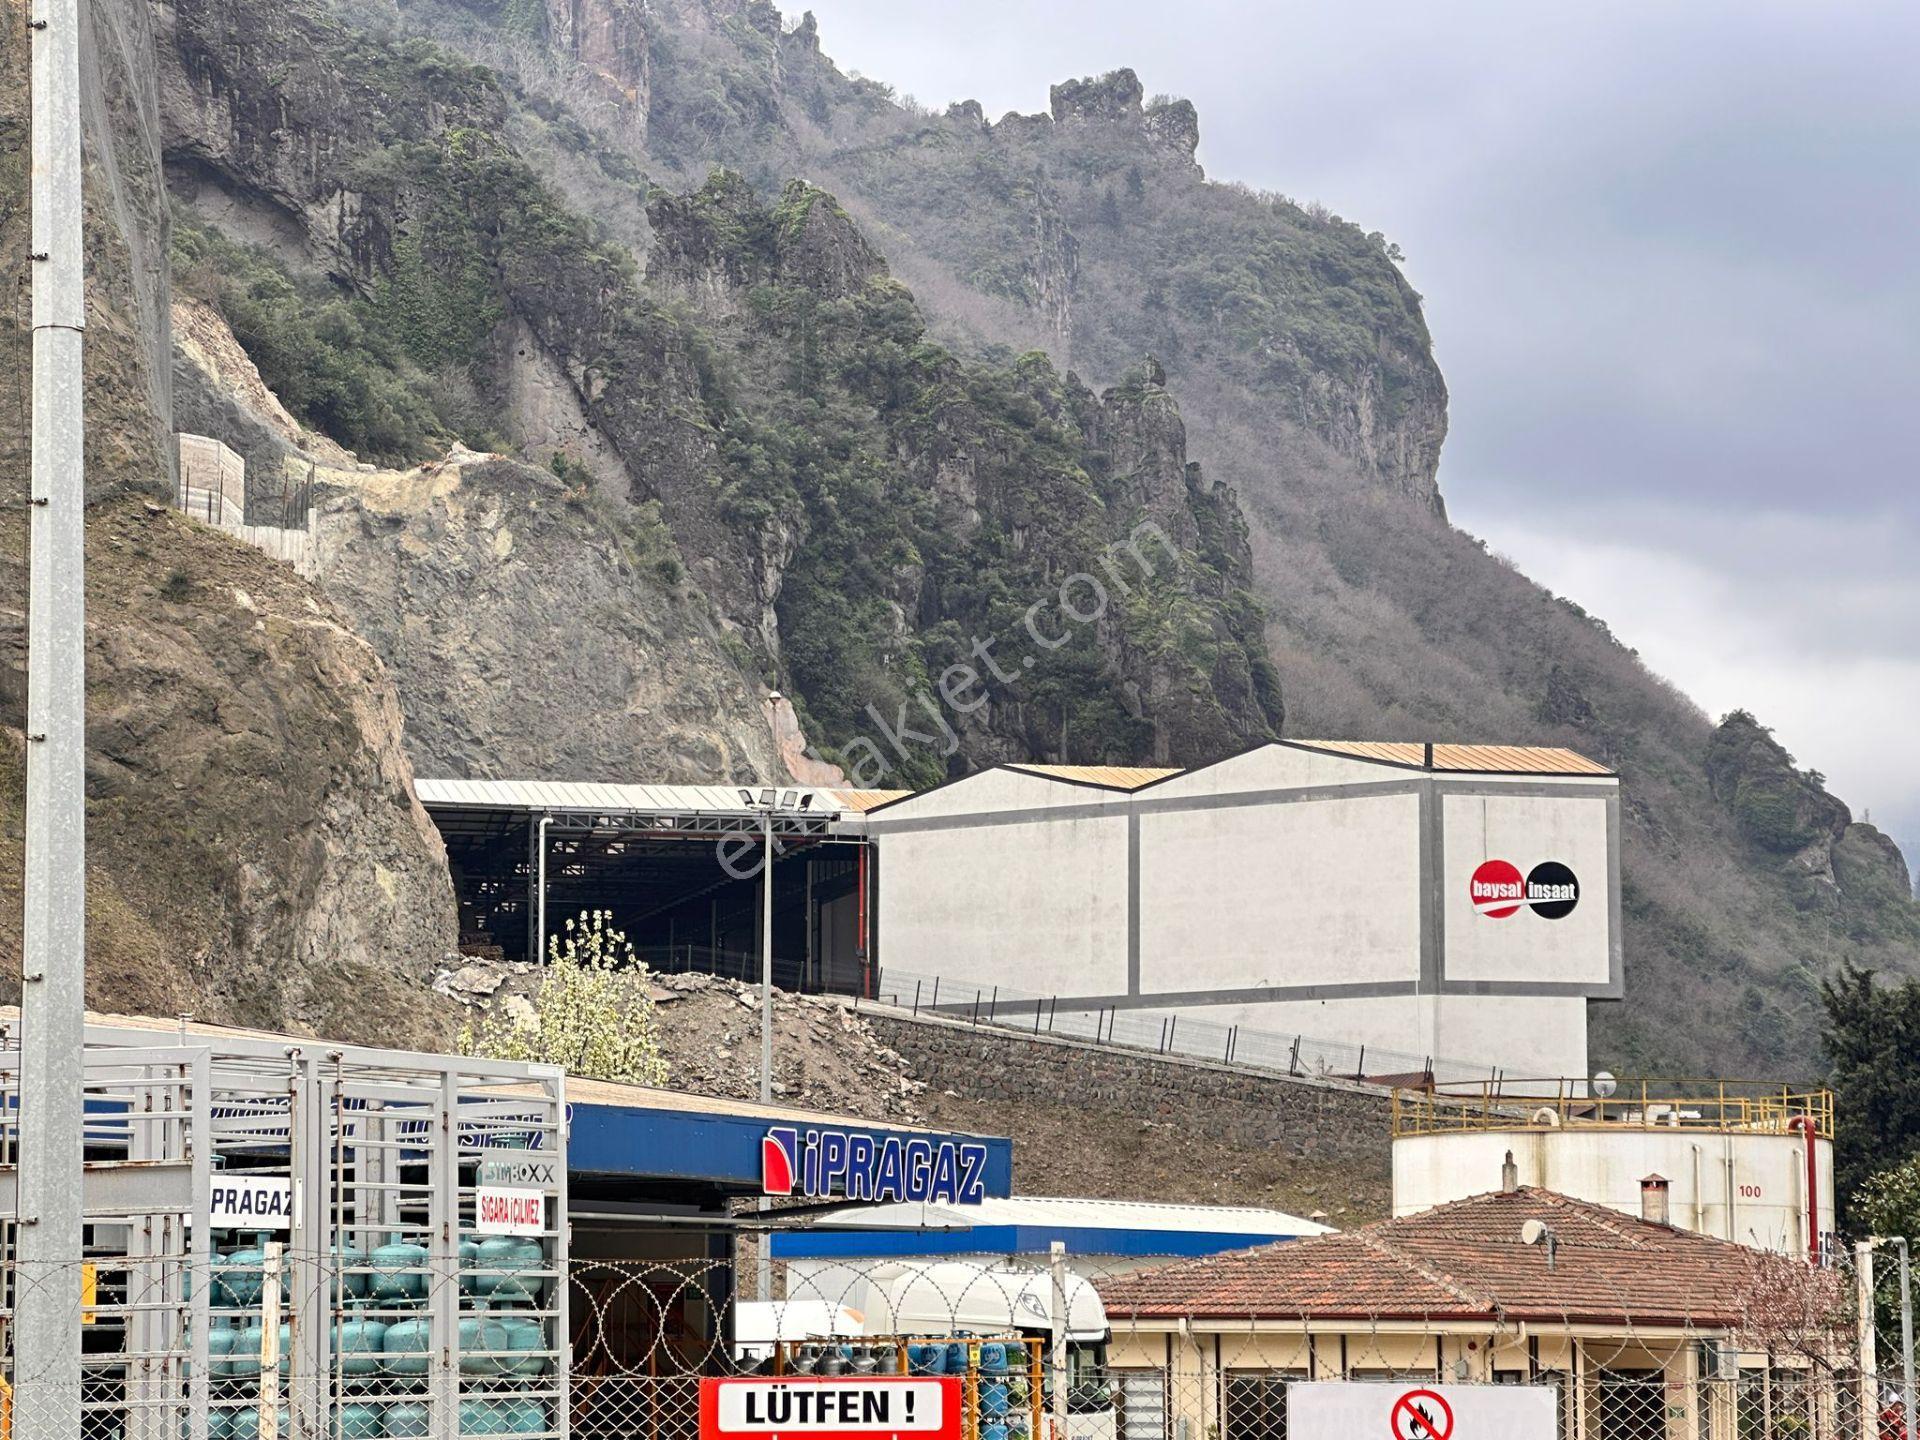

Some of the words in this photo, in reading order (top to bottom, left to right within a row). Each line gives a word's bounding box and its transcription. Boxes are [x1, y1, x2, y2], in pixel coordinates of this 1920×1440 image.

[1473, 880, 1522, 899] baysal
[1739, 1185, 1761, 1198] 100
[746, 1384, 890, 1425] LÜTFEN
